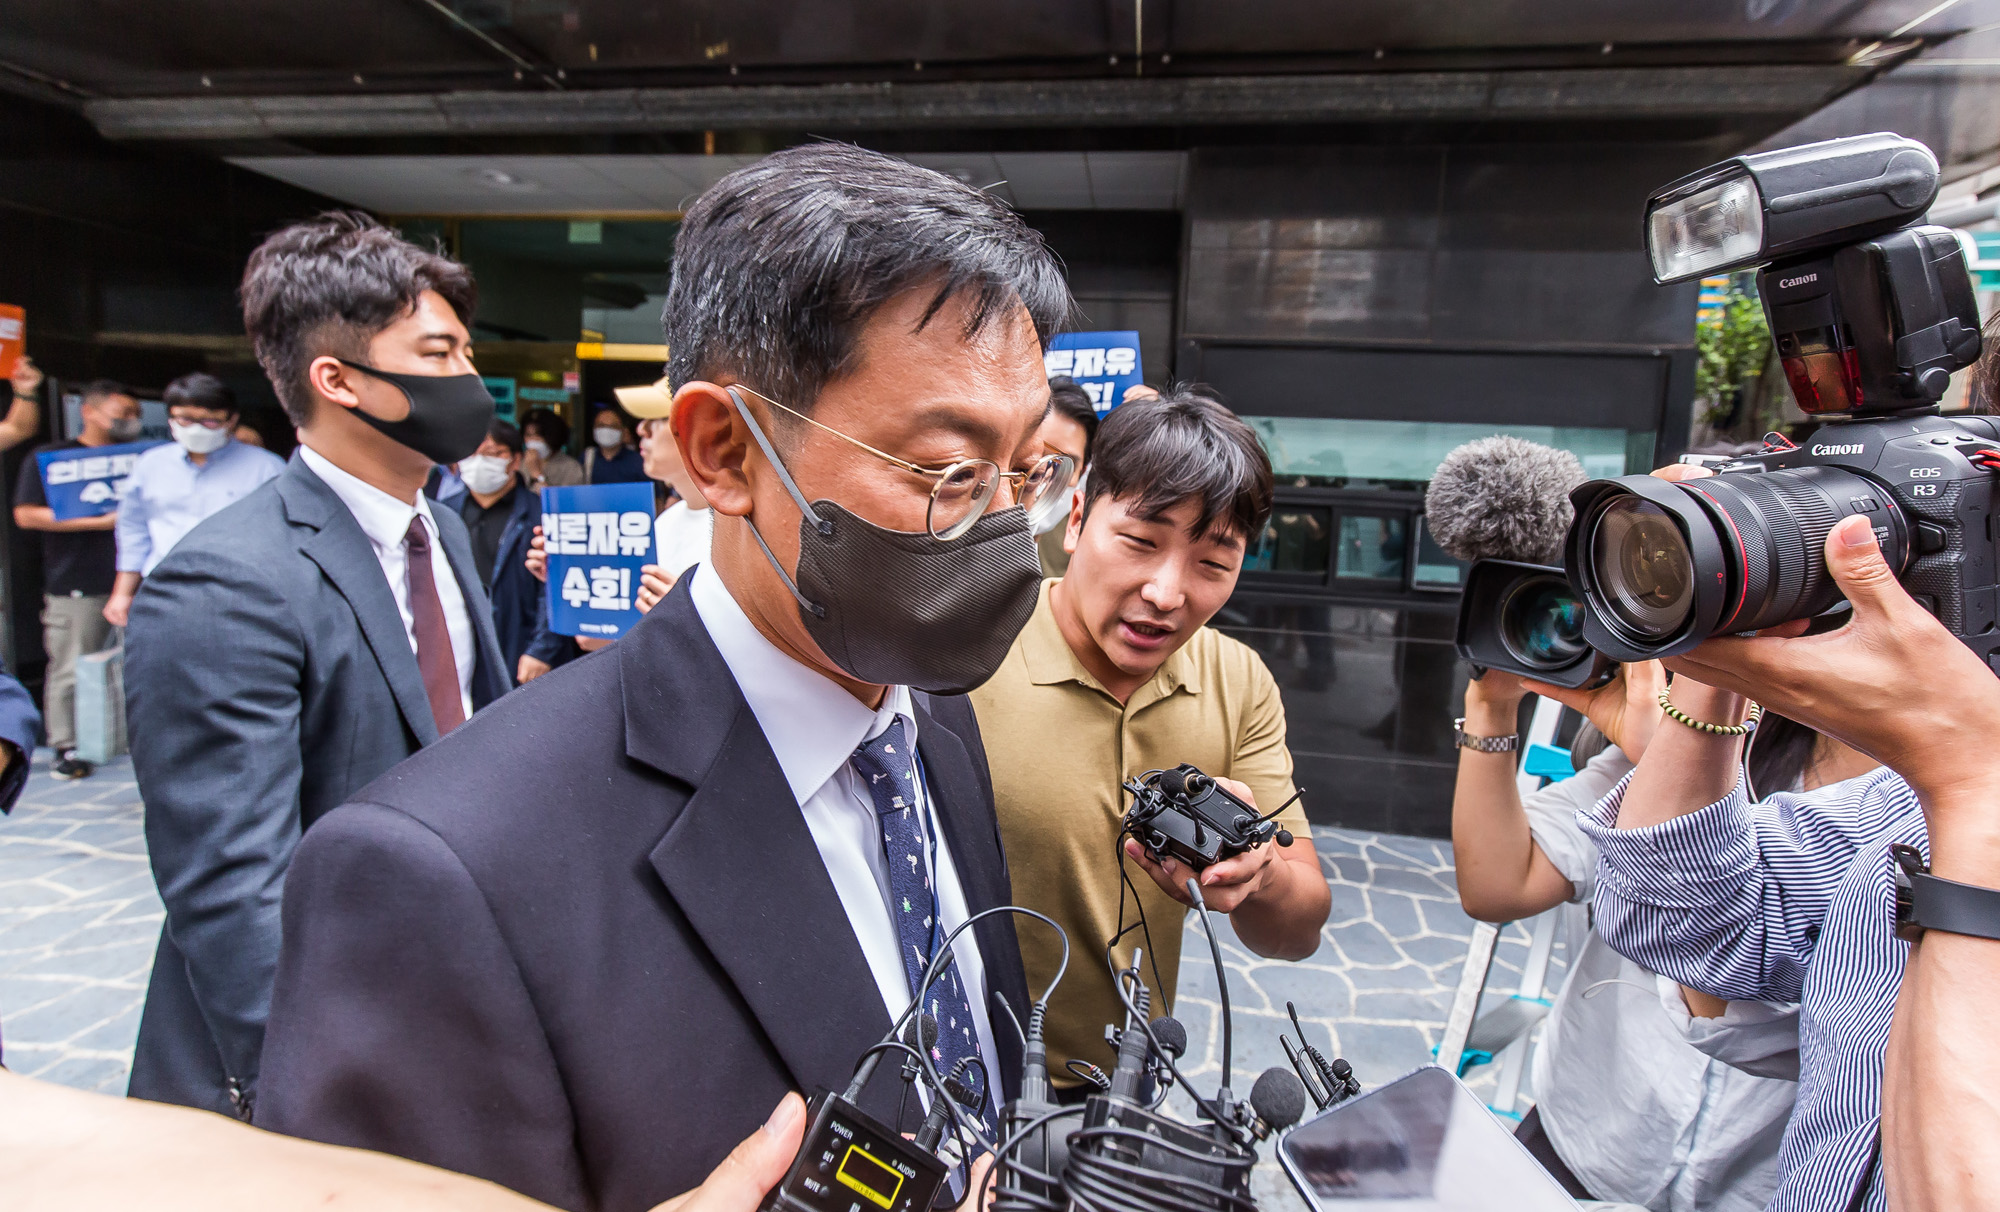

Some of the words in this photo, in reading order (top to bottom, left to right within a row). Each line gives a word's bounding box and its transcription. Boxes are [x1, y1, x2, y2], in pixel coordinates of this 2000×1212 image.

[1779, 273, 1817, 288] Canon
[1044, 347, 1136, 378] 론자유
[1811, 443, 1864, 456] Canon
[1909, 467, 1941, 478] EOS
[1913, 484, 1936, 496] R3
[562, 566, 631, 611] 수호!
[830, 1120, 853, 1141] POWER
[897, 1162, 916, 1179] AUDIO
[804, 1177, 821, 1193] MUTE
